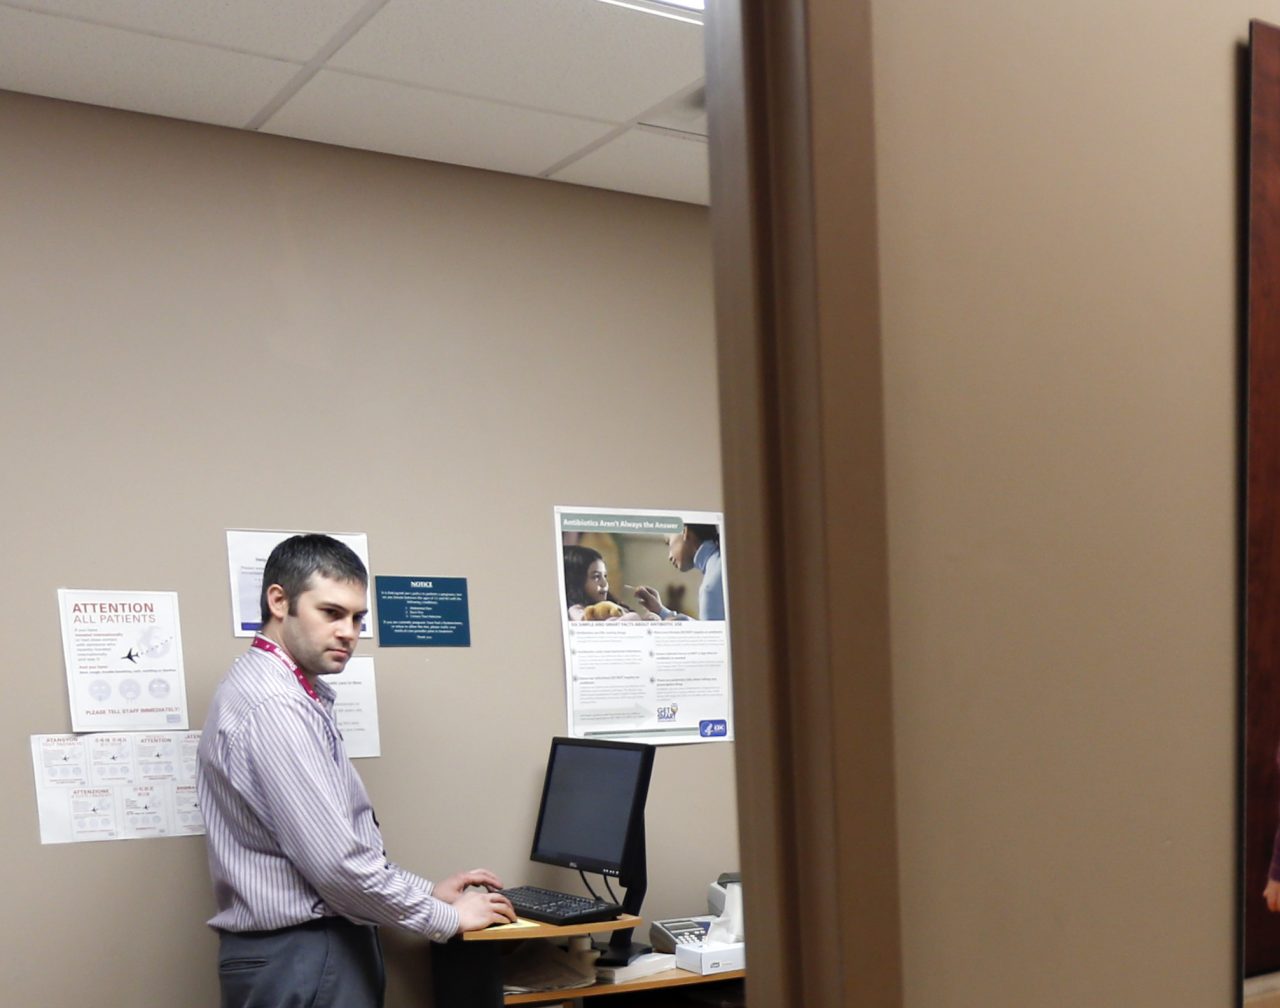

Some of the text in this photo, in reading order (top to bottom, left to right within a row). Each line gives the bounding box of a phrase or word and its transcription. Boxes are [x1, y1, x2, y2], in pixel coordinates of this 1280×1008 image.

[563, 519, 598, 527] Antibiotics
[643, 520, 654, 528] the
[72, 602, 154, 614] ATTENTION
[73, 614, 156, 624] ALL PATIENTS
